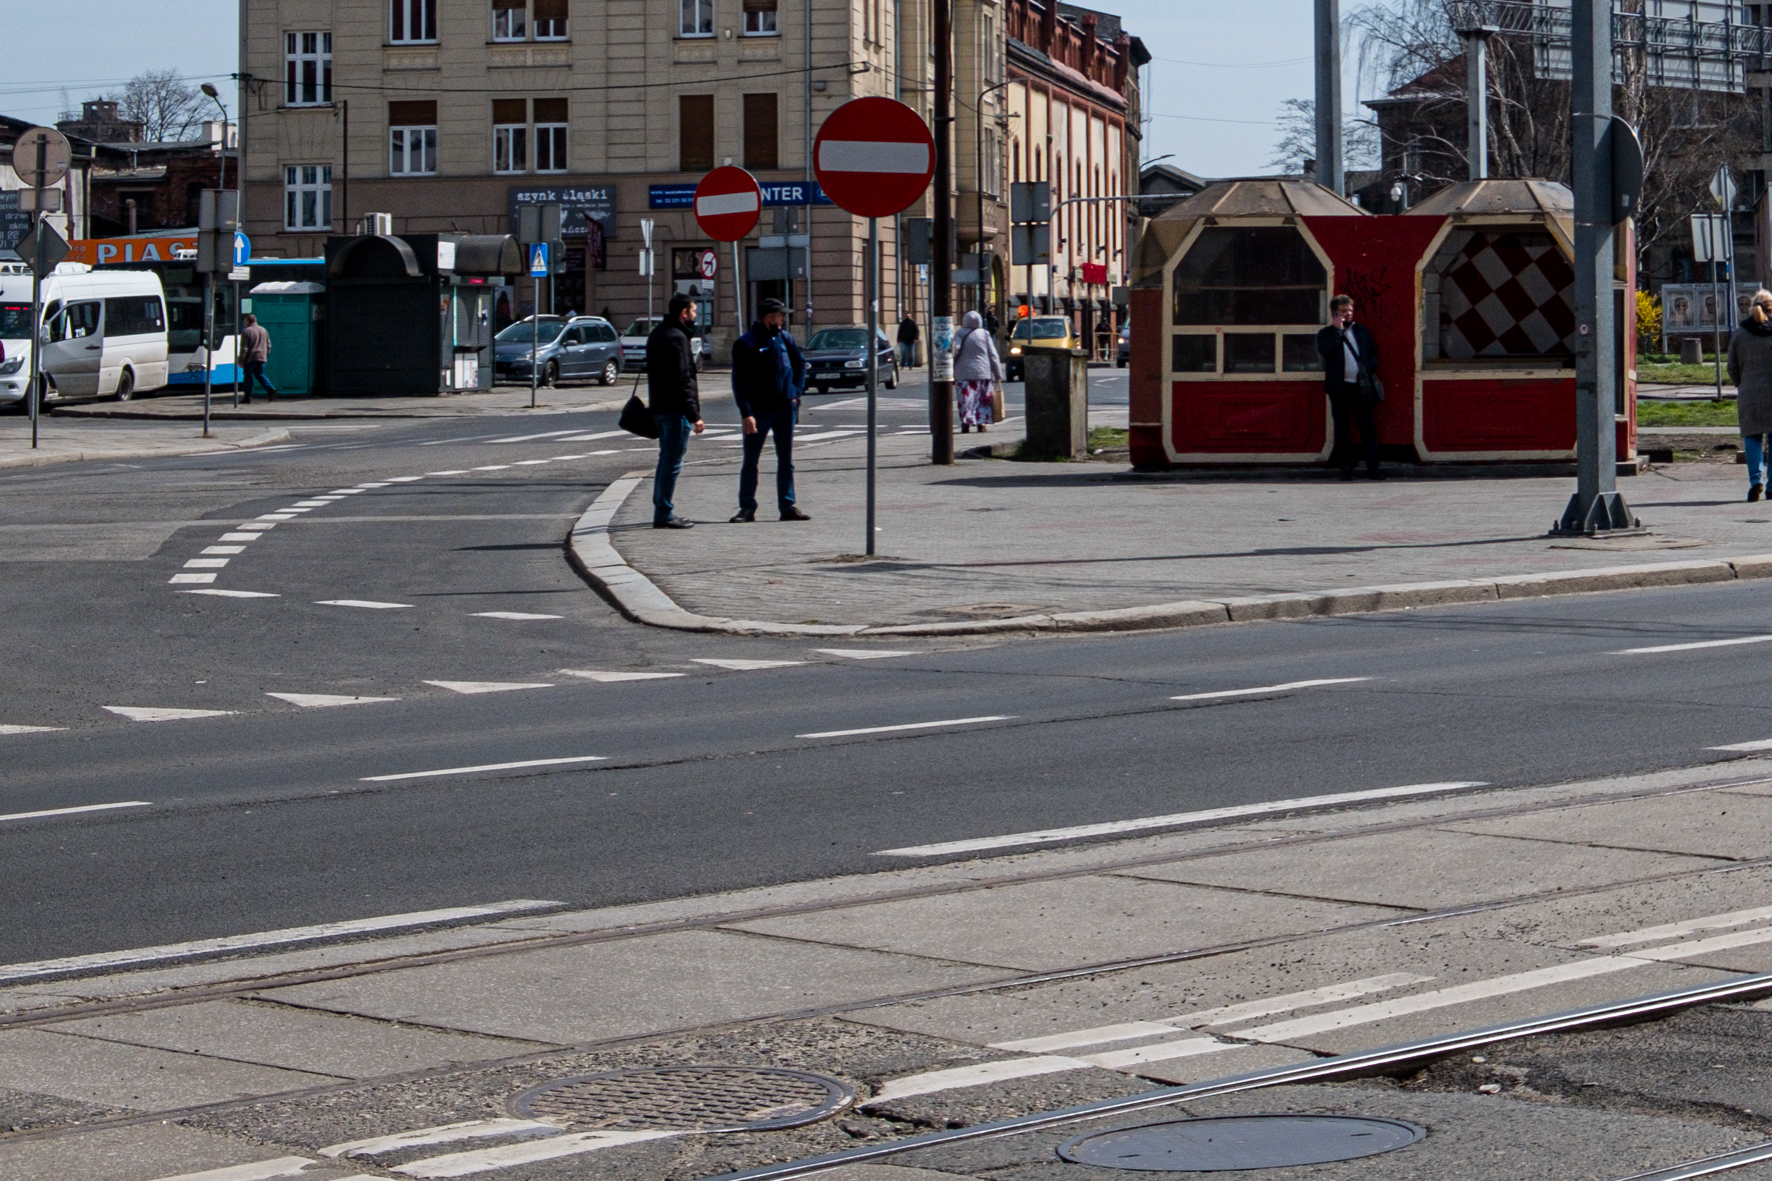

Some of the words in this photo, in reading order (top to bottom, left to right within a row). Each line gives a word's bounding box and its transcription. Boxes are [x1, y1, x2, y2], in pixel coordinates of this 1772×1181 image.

[517, 190, 556, 203] szynk
[562, 189, 607, 202] śląski
[760, 187, 803, 201] NTER
